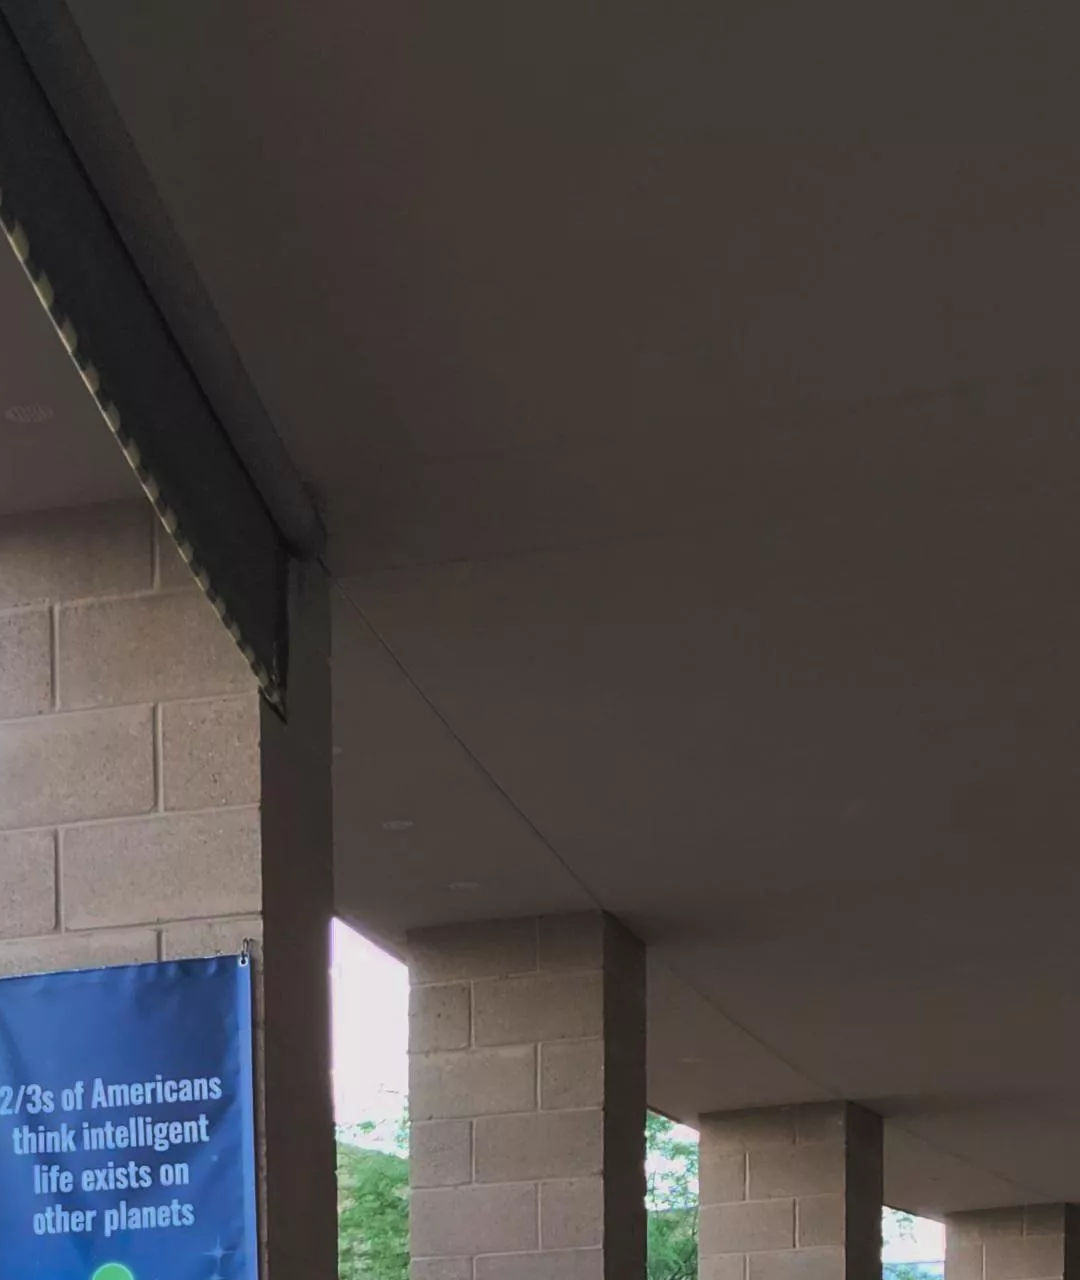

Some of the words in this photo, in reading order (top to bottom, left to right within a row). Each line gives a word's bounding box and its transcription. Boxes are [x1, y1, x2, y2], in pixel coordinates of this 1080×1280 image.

[0, 1084, 55, 1115] 2/3s
[61, 1081, 84, 1111] of
[91, 1074, 222, 1108] Americans
[12, 1123, 76, 1155] think
[83, 1114, 210, 1151] intelligent
[33, 1164, 73, 1194] life
[81, 1161, 153, 1191] exists
[160, 1162, 189, 1186] on
[33, 1204, 96, 1235] other
[104, 1199, 195, 1237] planets
